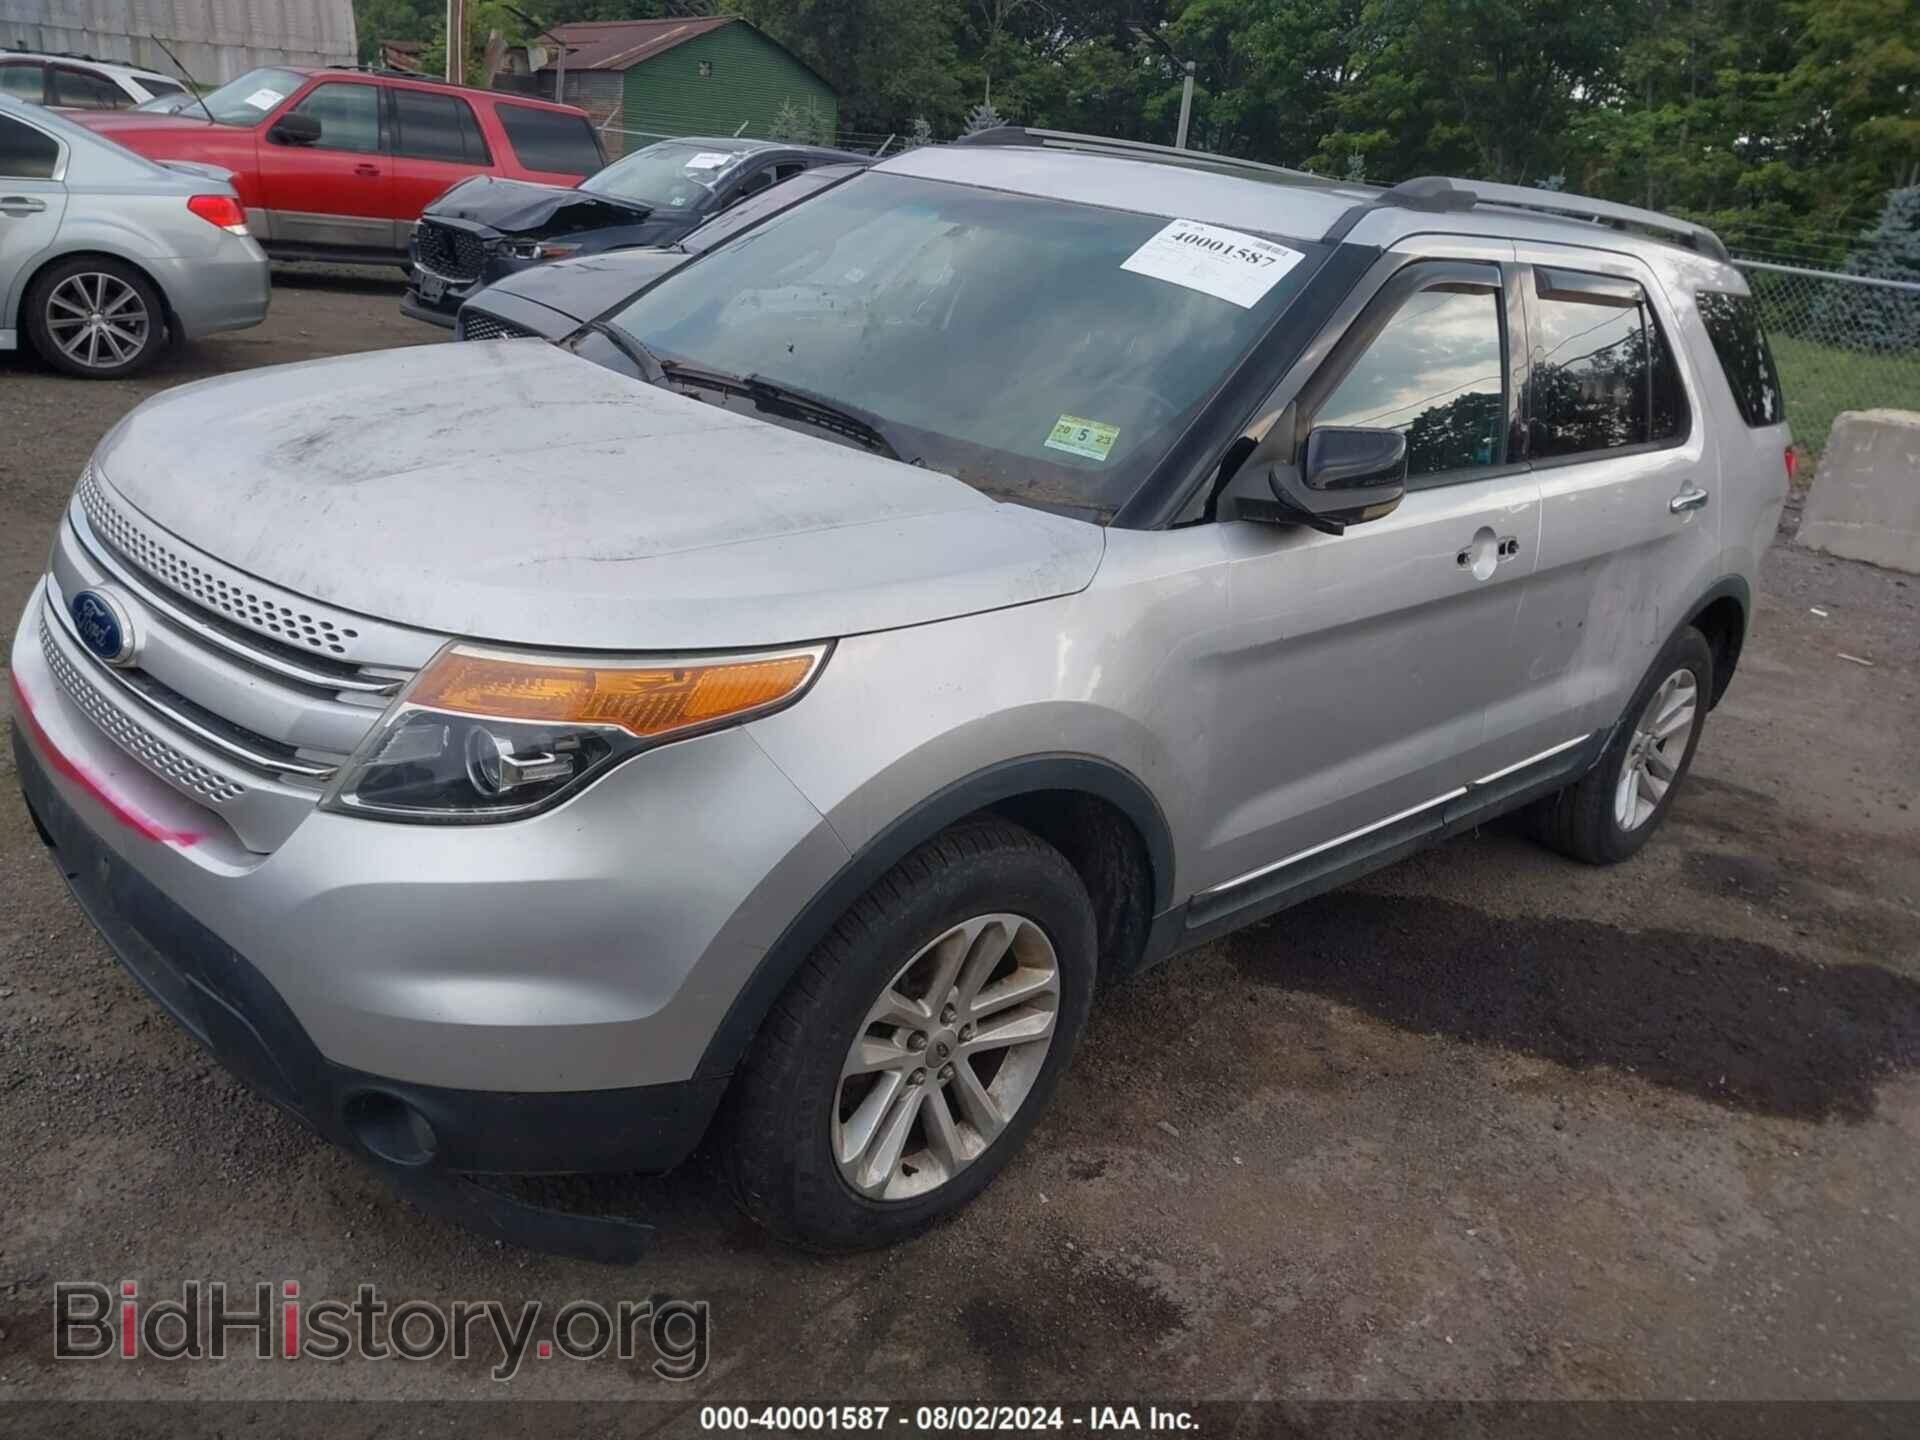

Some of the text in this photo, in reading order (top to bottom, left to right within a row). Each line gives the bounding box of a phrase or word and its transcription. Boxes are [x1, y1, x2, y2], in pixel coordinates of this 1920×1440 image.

[1172, 231, 1277, 268] 40001587
[1078, 428, 1090, 442] 5
[77, 598, 111, 647] Ford
